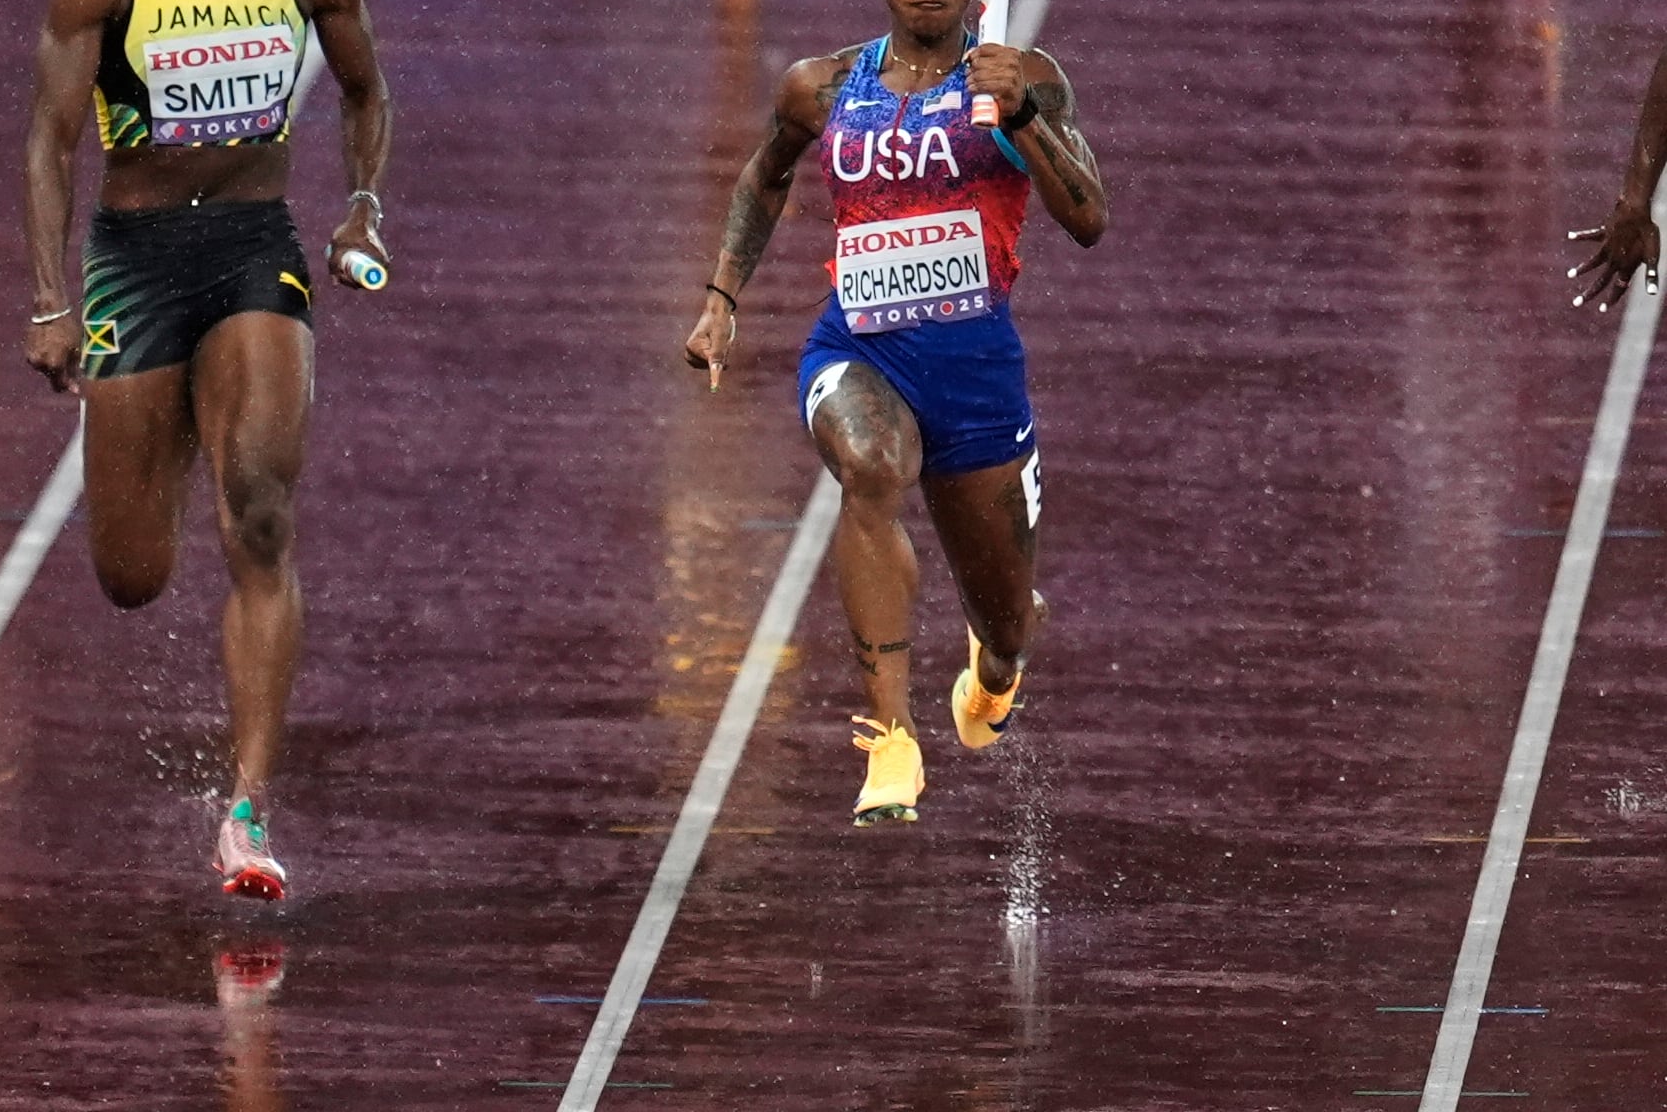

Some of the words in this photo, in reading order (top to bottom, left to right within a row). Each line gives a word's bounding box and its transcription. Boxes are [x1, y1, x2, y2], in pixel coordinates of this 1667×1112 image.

[148, 5, 294, 34] JAMAICA
[150, 36, 292, 72] HONDA
[164, 70, 284, 113] SMITH
[833, 126, 960, 182] USA
[839, 221, 978, 259] HONDA
[842, 253, 981, 304] RICHARDSON
